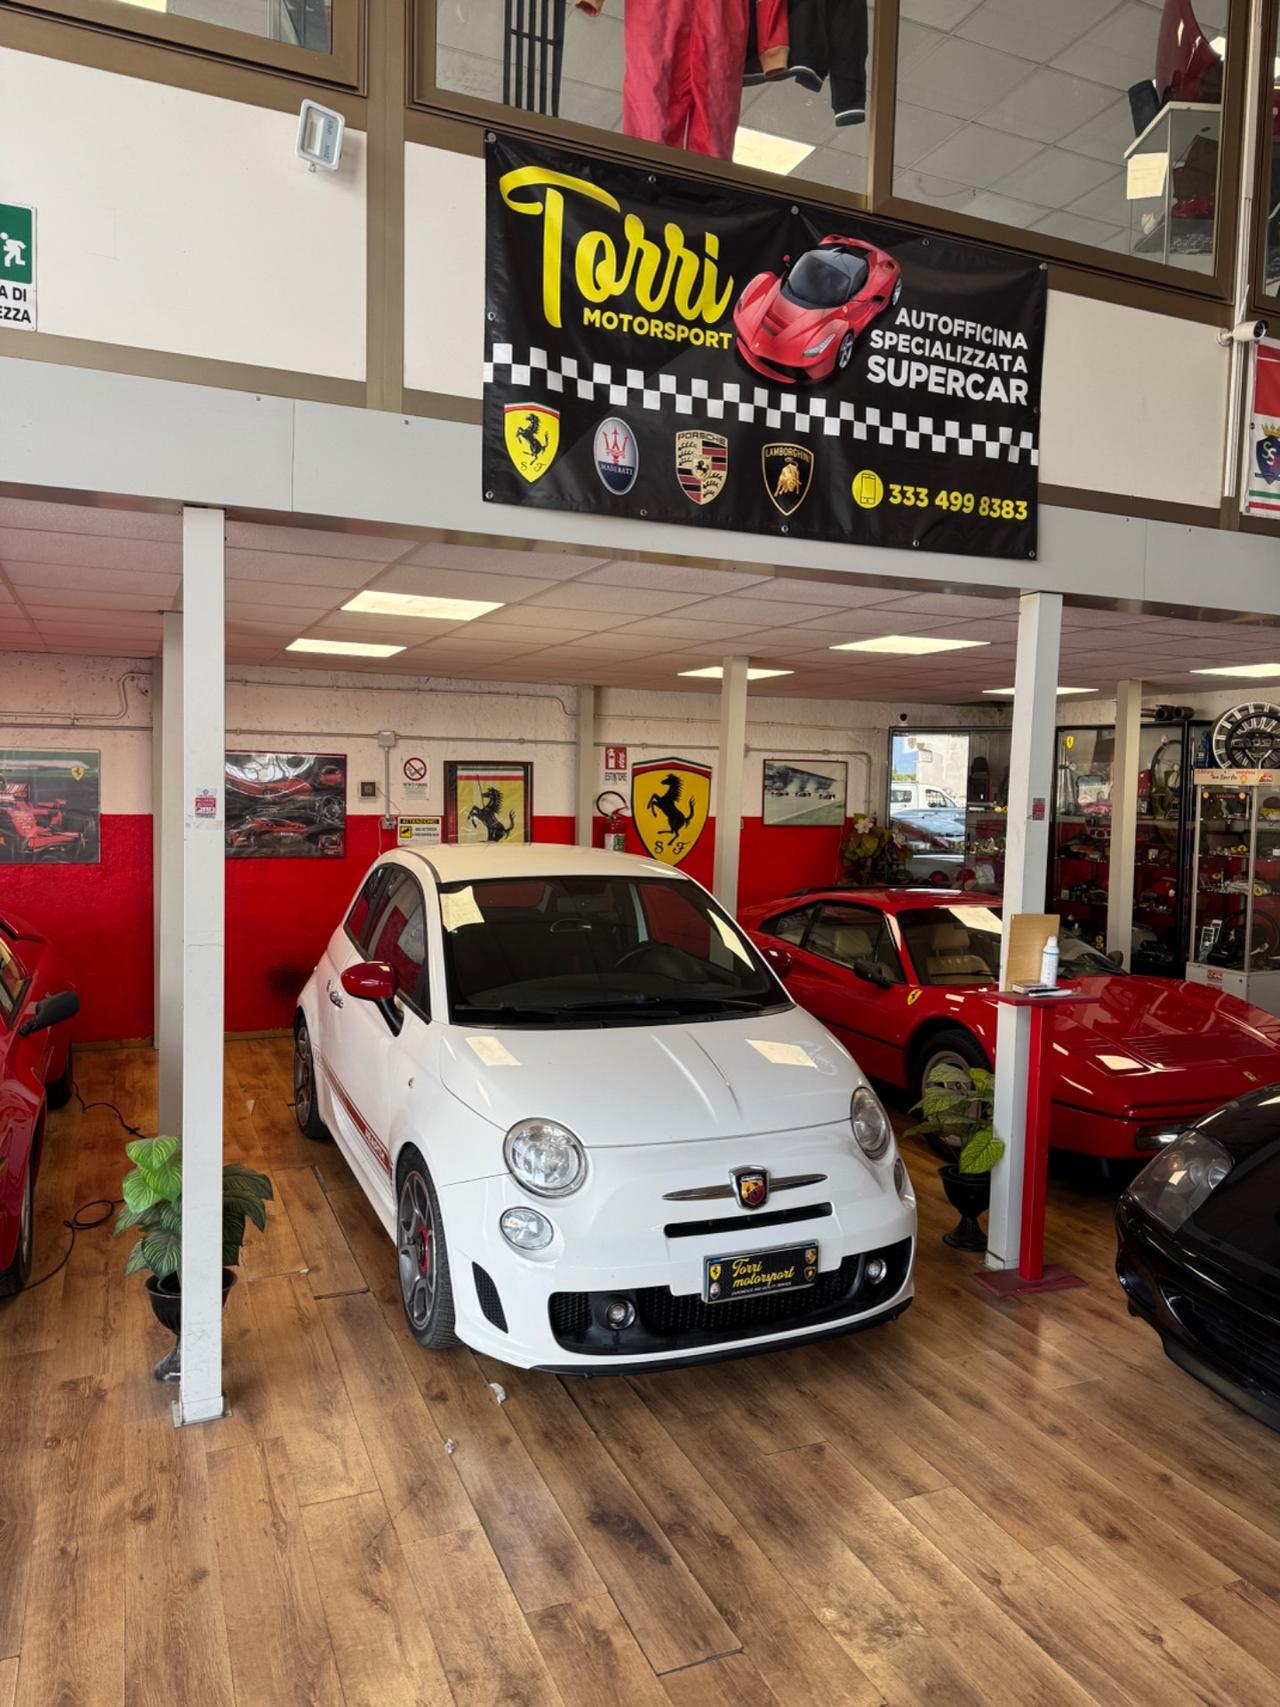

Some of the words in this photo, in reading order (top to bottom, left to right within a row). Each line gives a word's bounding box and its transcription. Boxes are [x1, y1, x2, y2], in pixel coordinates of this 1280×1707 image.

[499, 165, 734, 328] Torri
[12, 287, 27, 302] DI
[583, 307, 733, 349] MOTORSPORT
[895, 307, 1028, 349] AUTOFFICINA
[870, 329, 1028, 374] SPECIALIZZATA
[866, 354, 1029, 406] SUPERCAR
[677, 431, 726, 446] PORSCHE
[765, 447, 811, 463] LAMBORGHINI
[600, 463, 633, 475] MASERATI
[889, 483, 929, 508] 333
[935, 490, 975, 514] 499
[978, 495, 1028, 521] 8383
[654, 840, 664, 854] S
[731, 1257, 763, 1278] Torri
[732, 1265, 796, 1288] motorsport
